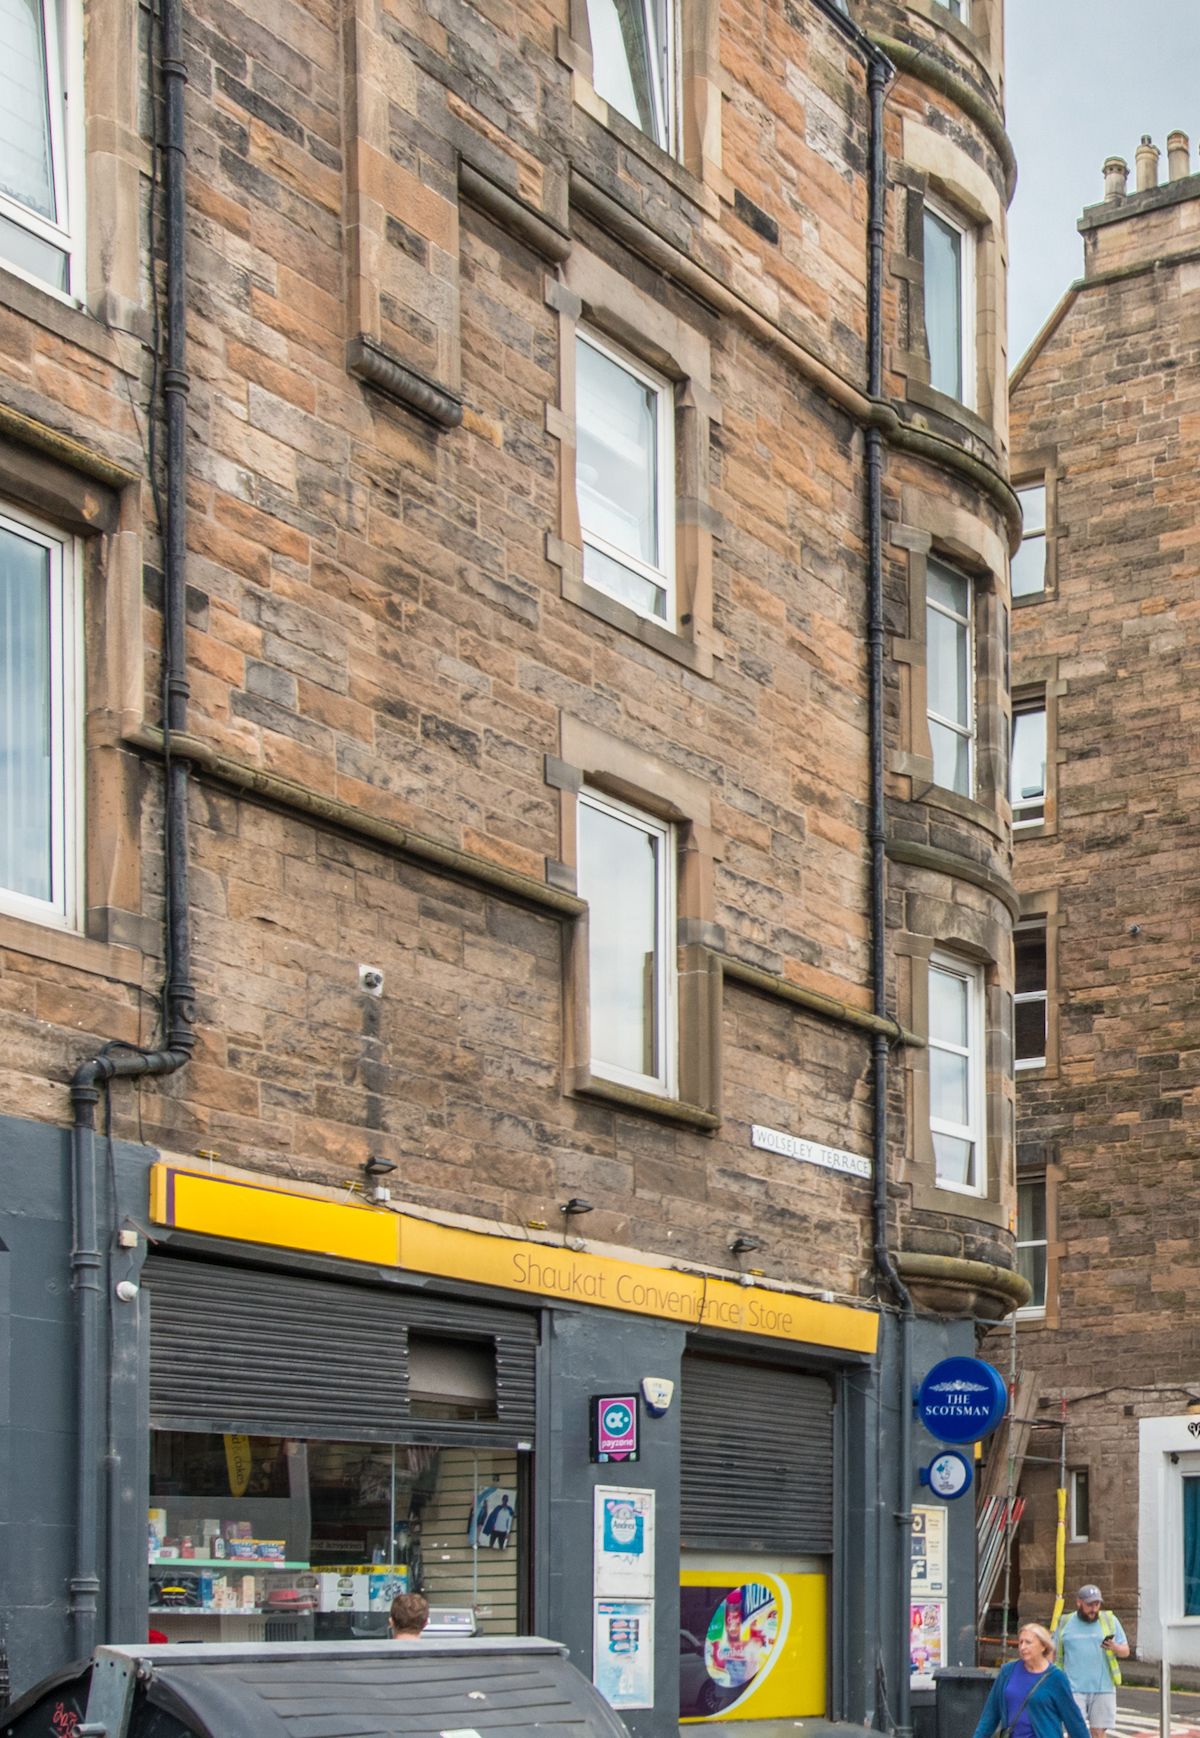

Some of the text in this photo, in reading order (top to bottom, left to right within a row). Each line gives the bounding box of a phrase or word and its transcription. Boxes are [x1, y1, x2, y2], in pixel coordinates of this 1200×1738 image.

[757, 1130, 869, 1174] WOLSELEY TERRACE
[512, 1253, 793, 1333] Shaukat Convenience Store
[946, 1394, 970, 1404] THE
[925, 1406, 990, 1416] SCOTSMAN
[601, 1438, 634, 1449] payzone
